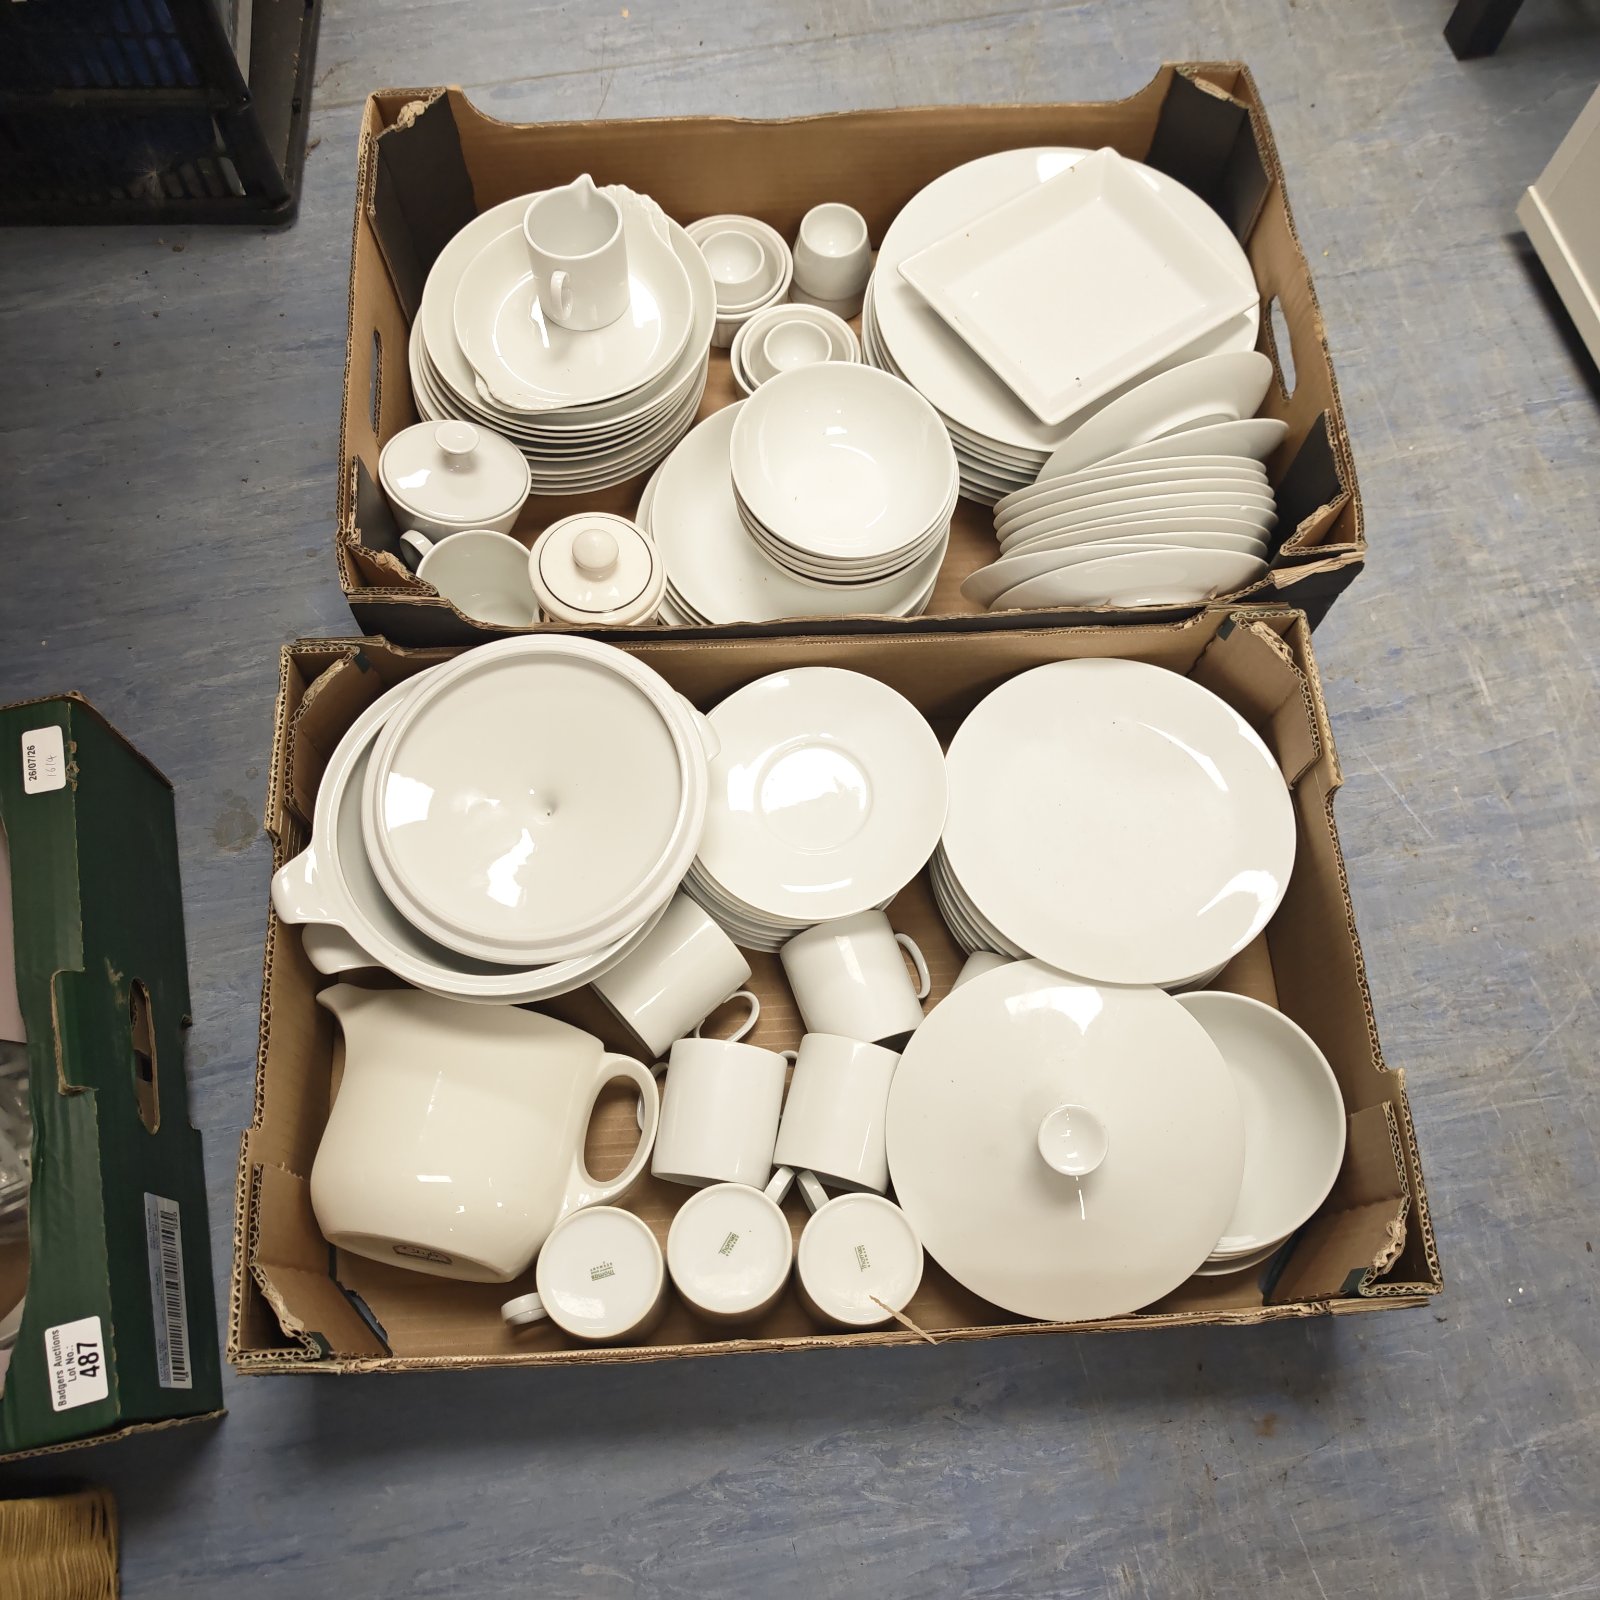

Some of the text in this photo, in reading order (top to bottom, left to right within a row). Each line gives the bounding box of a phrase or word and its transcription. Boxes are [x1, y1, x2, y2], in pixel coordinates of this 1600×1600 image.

[27, 745, 37, 781] 26/07/26
[718, 1232, 737, 1255] Thomas
[855, 1245, 867, 1272] Thomas
[52, 1329, 67, 1407] Badgers Auctions
[67, 1367, 77, 1382] Lot
[77, 1343, 100, 1377] 487
